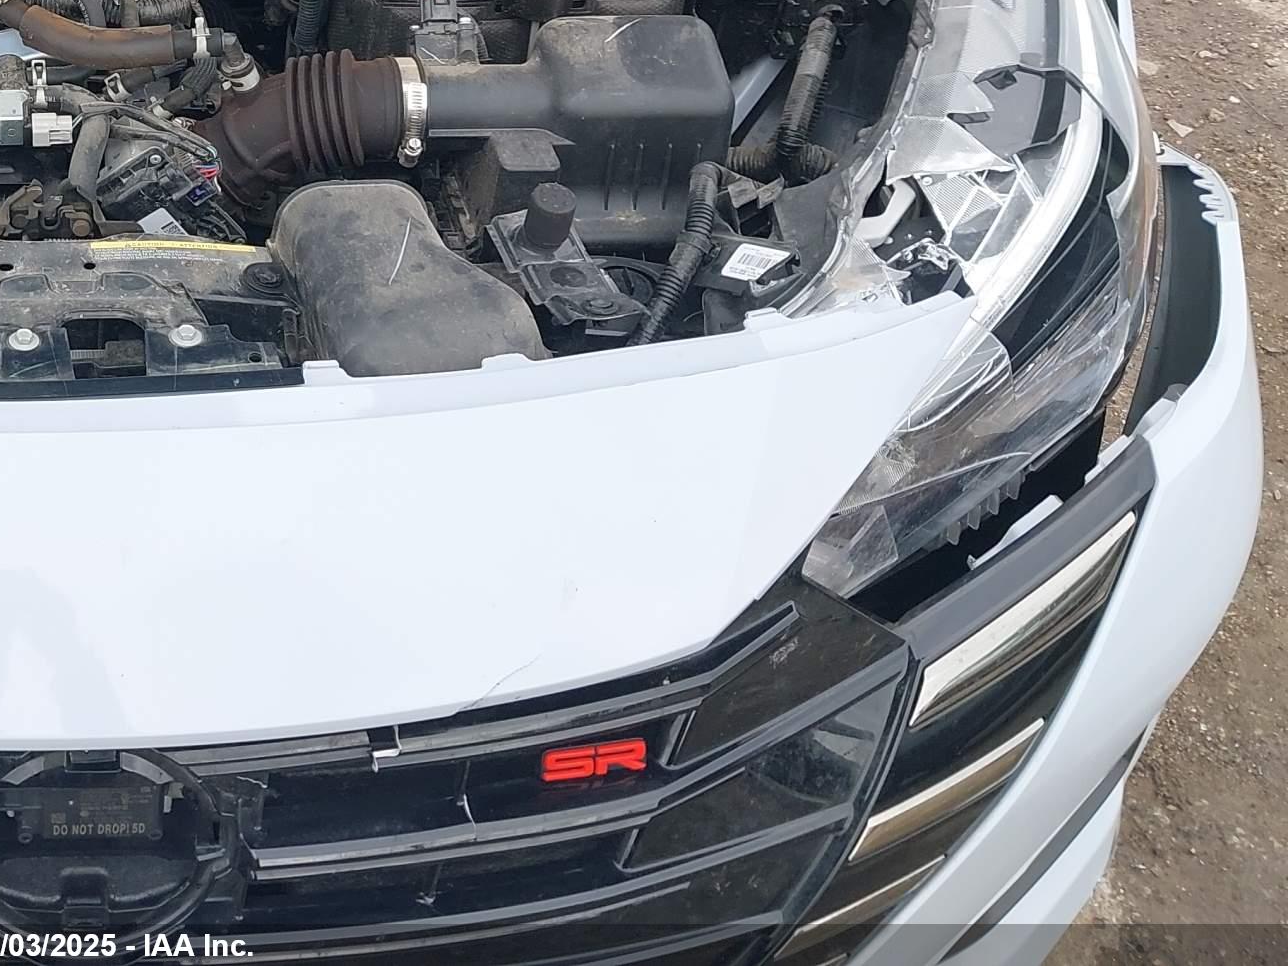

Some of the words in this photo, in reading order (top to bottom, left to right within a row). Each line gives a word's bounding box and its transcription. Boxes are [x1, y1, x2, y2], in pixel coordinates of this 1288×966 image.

[543, 738, 647, 782] SR
[53, 824, 68, 835] DO
[72, 824, 94, 834] NOT
